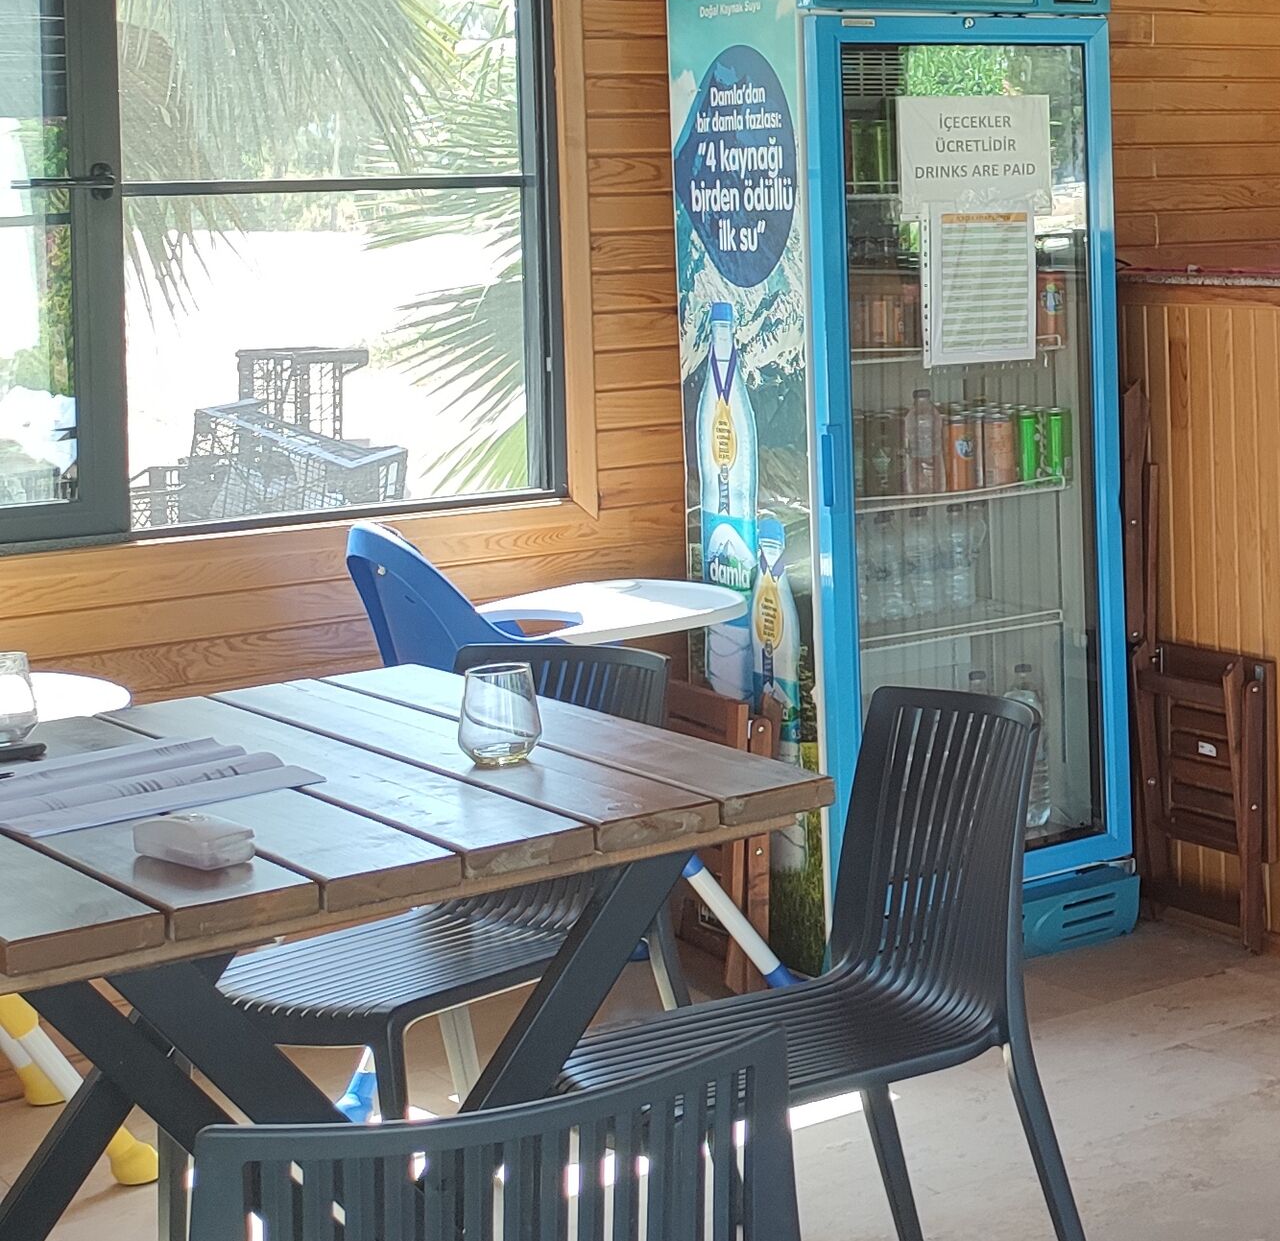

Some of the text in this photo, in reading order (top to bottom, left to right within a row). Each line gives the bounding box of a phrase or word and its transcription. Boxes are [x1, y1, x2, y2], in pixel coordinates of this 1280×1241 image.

[697, 107, 782, 133] bir damla fazlası:
[939, 113, 1012, 132] İÇECEKLER
[720, 136, 783, 179] kaynağı
[935, 136, 1017, 153] ÜCRETLİDİR
[915, 163, 1036, 179] DRINKS ARE PAID
[690, 175, 793, 217] birden ödüllü
[718, 219, 737, 252] ilk
[709, 559, 750, 589] damla
